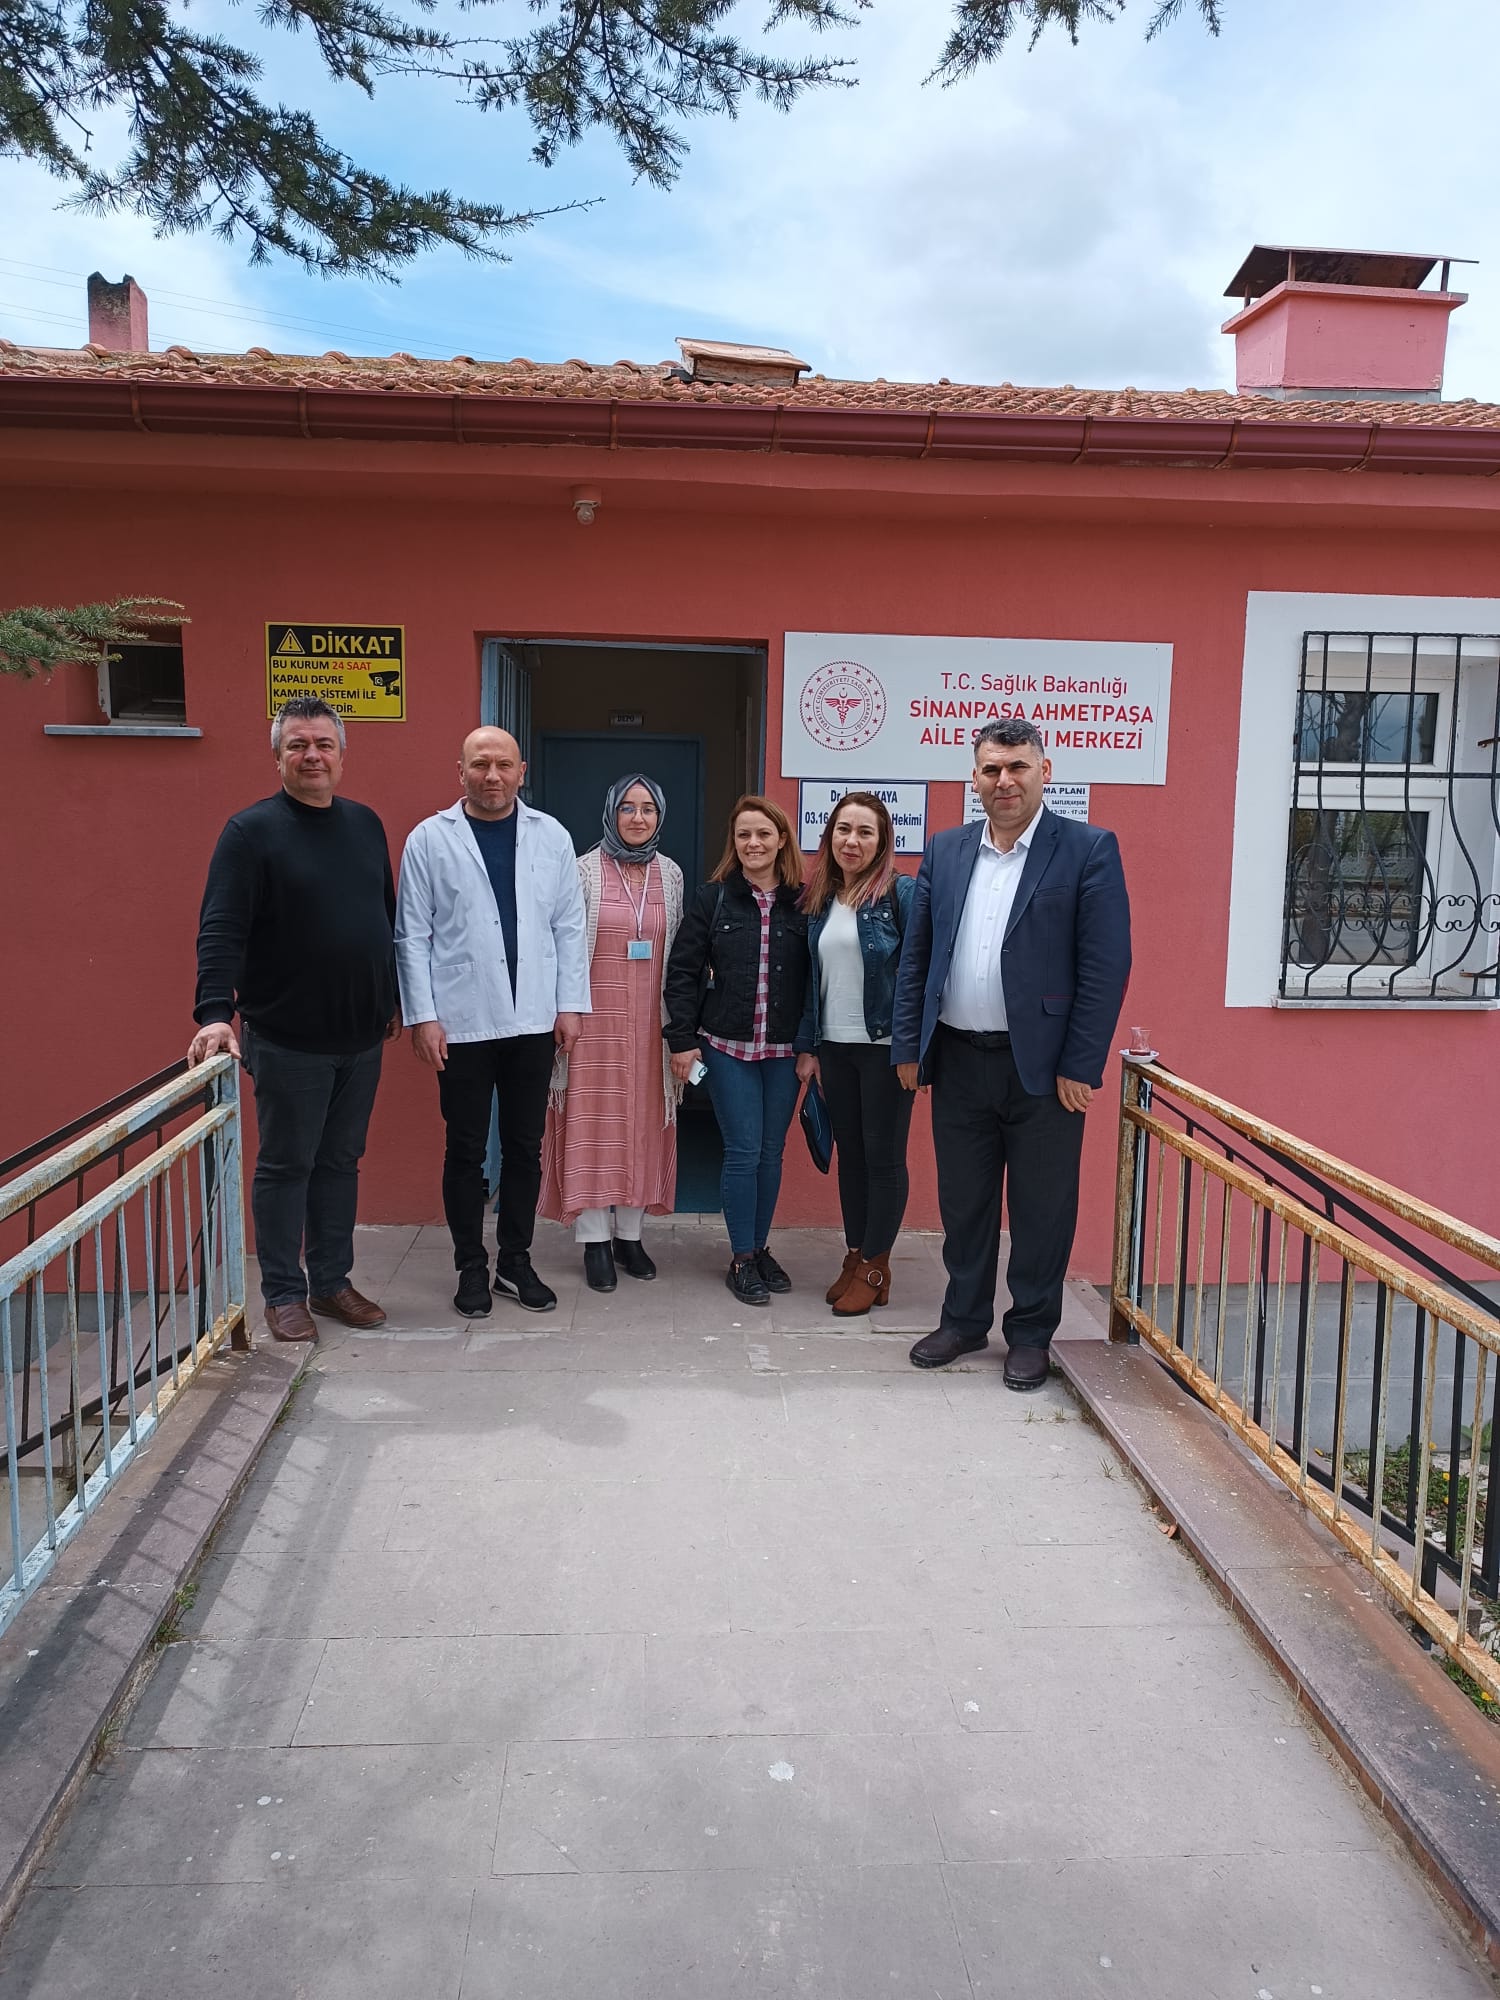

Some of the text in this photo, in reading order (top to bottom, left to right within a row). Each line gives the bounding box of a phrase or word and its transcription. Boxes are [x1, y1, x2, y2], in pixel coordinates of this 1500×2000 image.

[311, 631, 395, 655] DİKKAT
[273, 660, 372, 670] BU KURUM 24 SAAT
[273, 674, 344, 684] KAPALI DEVRE
[941, 672, 1127, 698] T.C. Sağlık Bakanlığı
[273, 688, 377, 699] KAMERA SİSTEMİ İLE
[1031, 703, 1153, 725] AHMETPAŞA
[920, 723, 965, 745] AİLE
[1055, 728, 1142, 749] MERKEZİ
[874, 790, 898, 803] KAYA
[1059, 787, 1086, 795] PLANI
[891, 813, 922, 826] Hekimi
